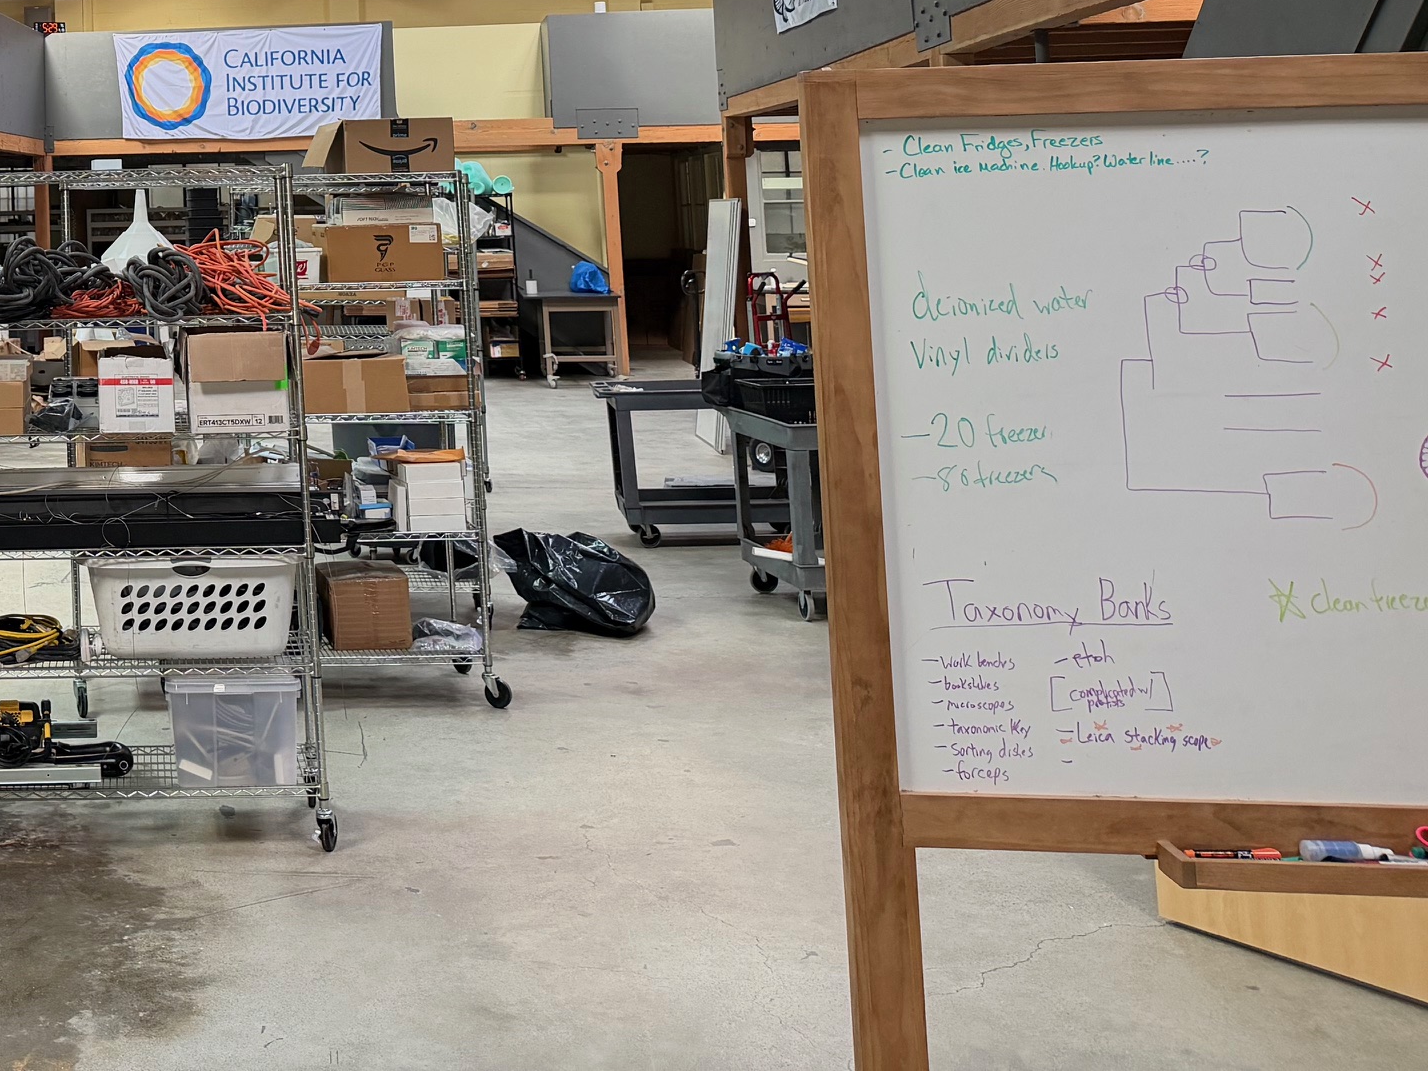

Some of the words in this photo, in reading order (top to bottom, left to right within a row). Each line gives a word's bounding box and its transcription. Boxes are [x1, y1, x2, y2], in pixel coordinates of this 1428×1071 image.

[223, 47, 347, 69] CALIFORNIA
[226, 72, 329, 93] INSTITUTE
[336, 70, 372, 87] FOR
[226, 94, 361, 117] BIODIVERSITY
[902, 134, 954, 156] Clean
[953, 160, 972, 174] ice
[1033, 285, 1093, 315] water
[922, 579, 1081, 636] Taxonomy
